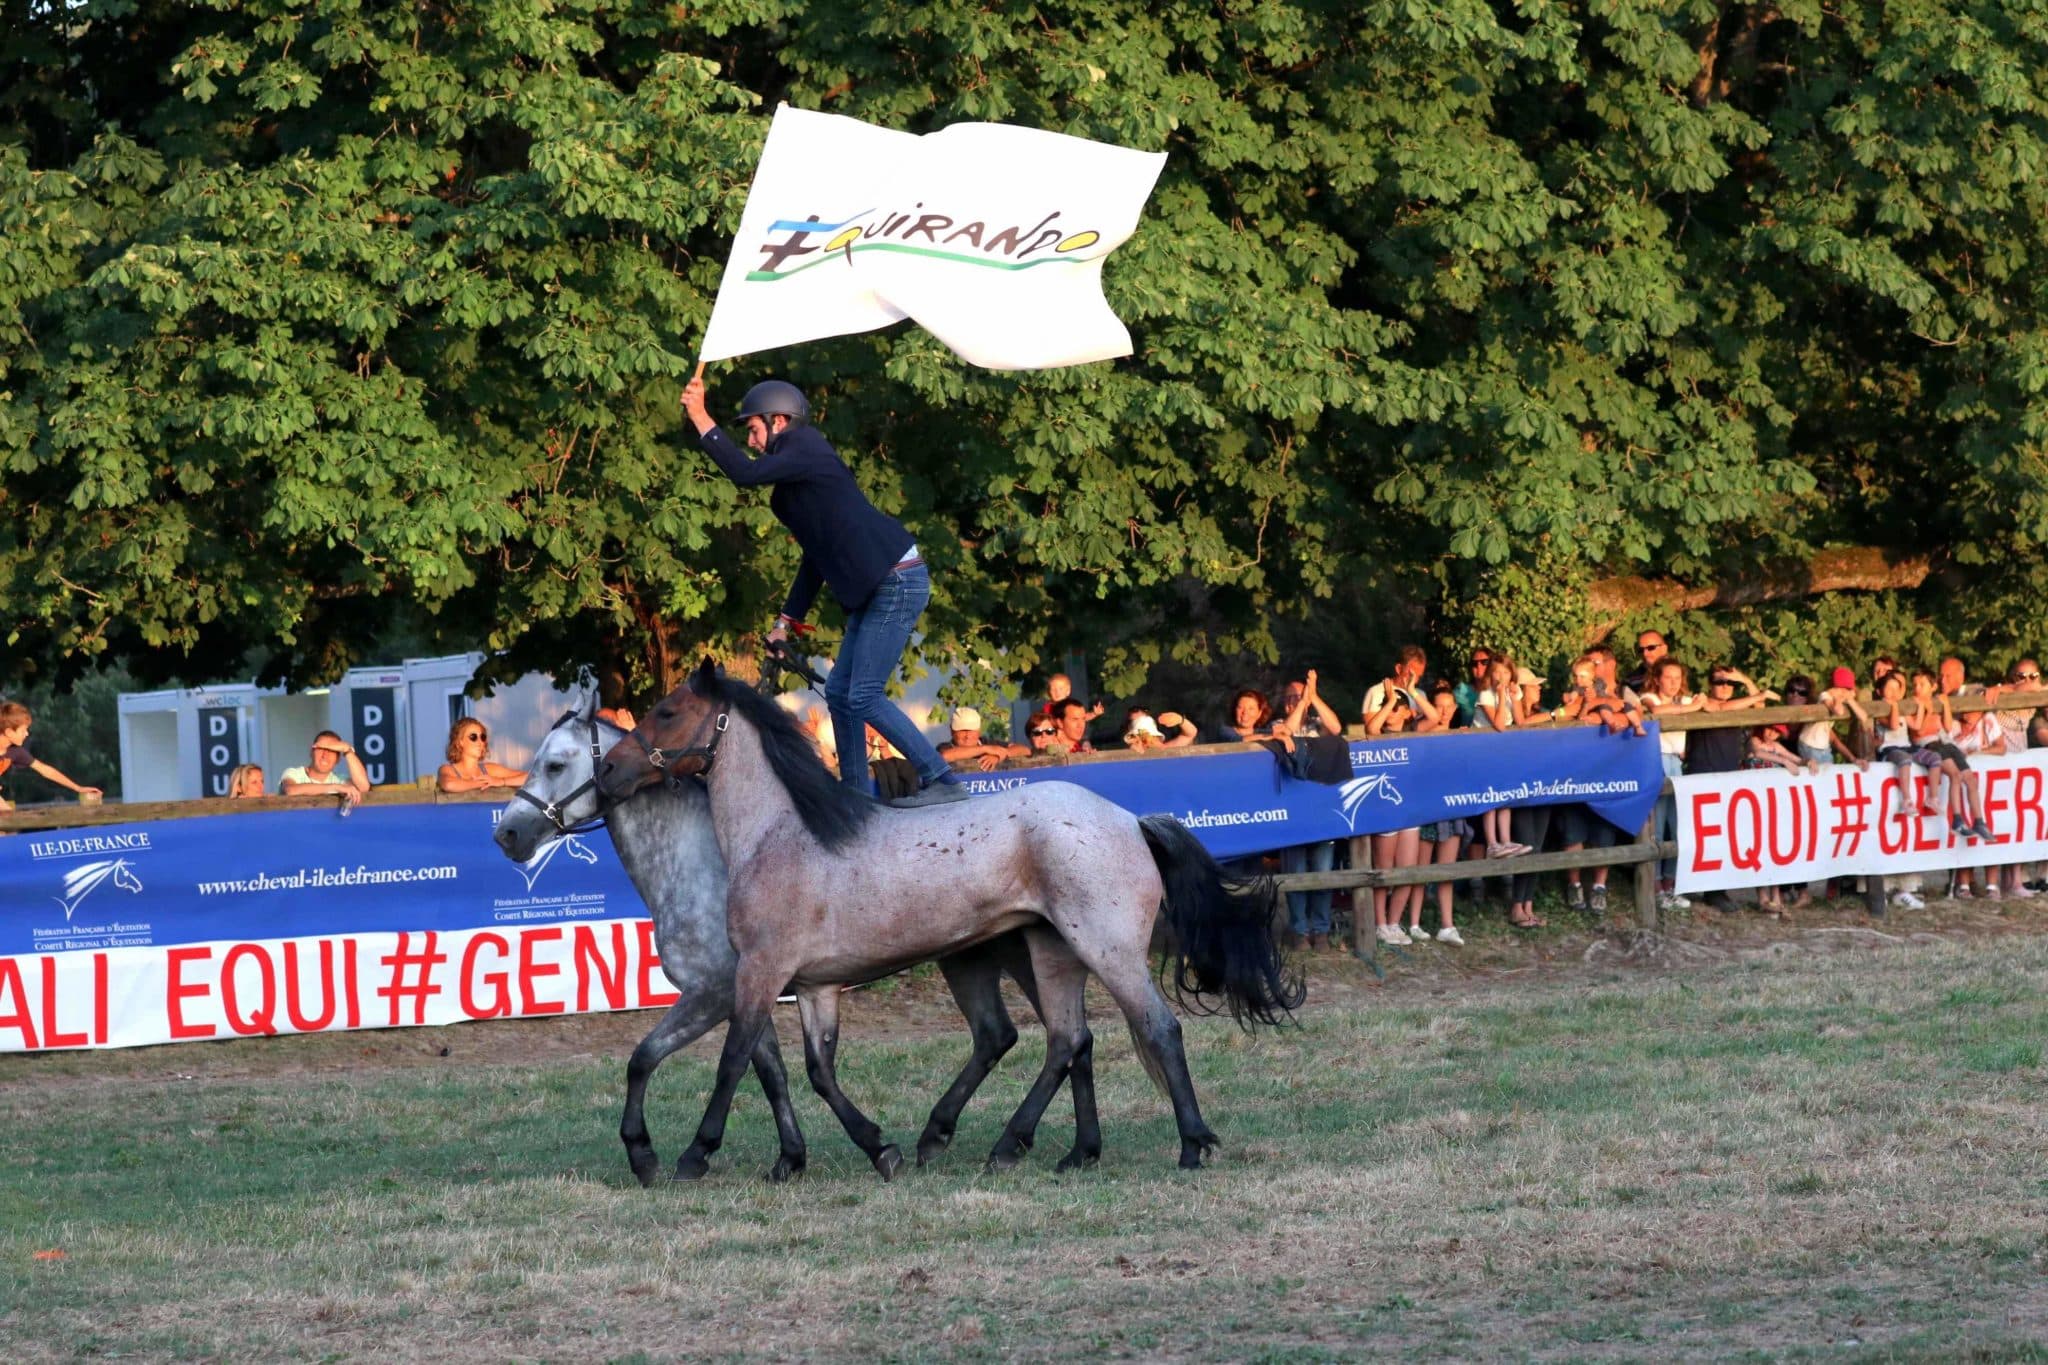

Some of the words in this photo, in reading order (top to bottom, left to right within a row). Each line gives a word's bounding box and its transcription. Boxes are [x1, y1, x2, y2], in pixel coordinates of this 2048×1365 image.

[1443, 778, 1639, 807] www.cheval-iledefrance.com
[30, 832, 151, 857] ILE-DE-FRANCE
[198, 865, 457, 895] www.cheval-iledefrance.com
